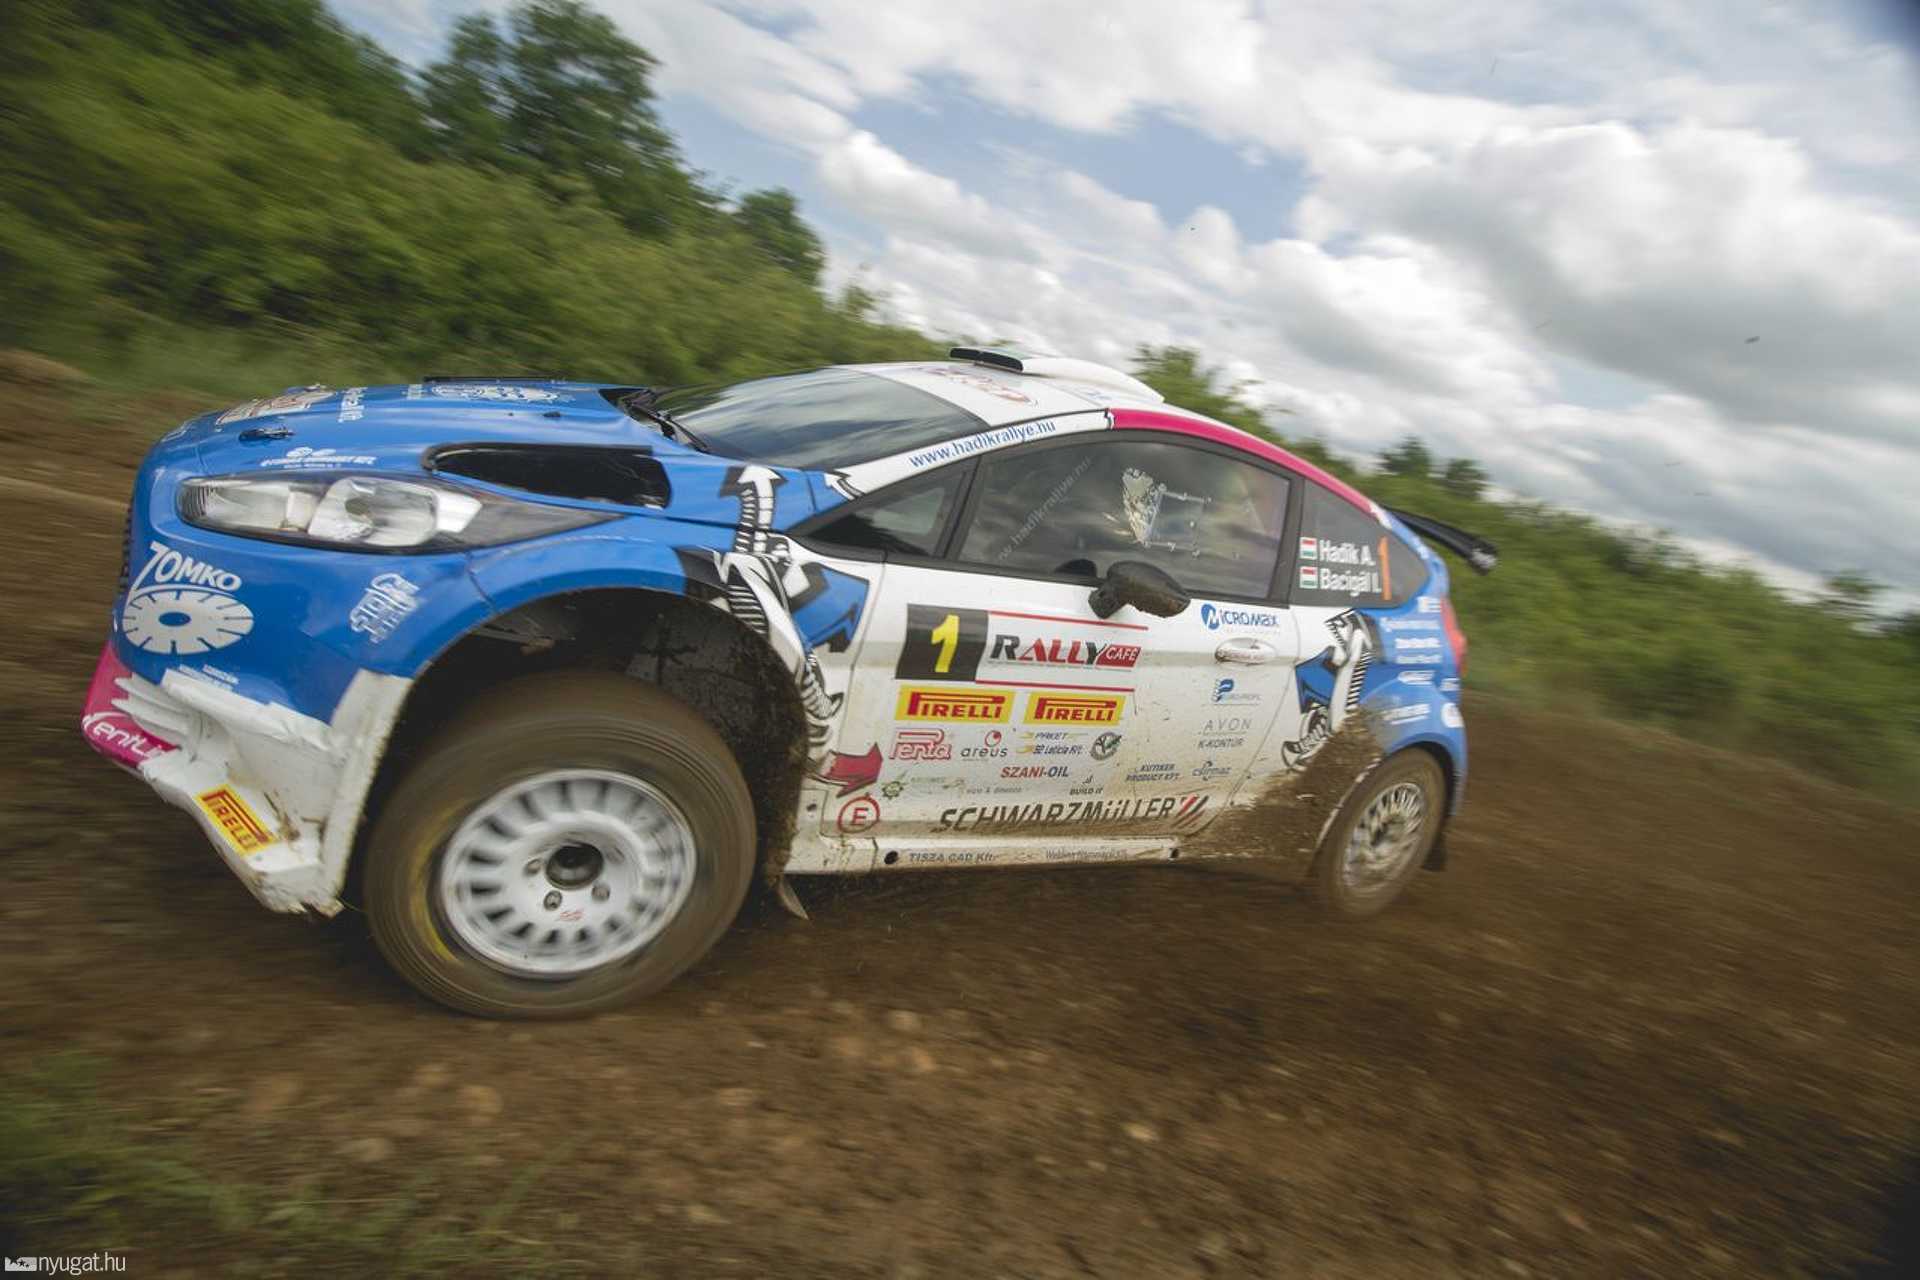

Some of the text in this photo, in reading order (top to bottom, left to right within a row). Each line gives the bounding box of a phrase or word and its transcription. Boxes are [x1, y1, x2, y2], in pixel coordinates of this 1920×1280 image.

[909, 420, 1057, 468] www.hadikrallye.hu
[1377, 535, 1393, 601] 1
[931, 614, 960, 674] 1
[990, 634, 1108, 665] RALLY
[907, 691, 1006, 719] PIRELLI
[1034, 697, 1118, 721] PIRELLI
[1203, 718, 1253, 731] AVON
[960, 745, 1009, 758] areus
[1001, 765, 1070, 778] SZANI-OIL
